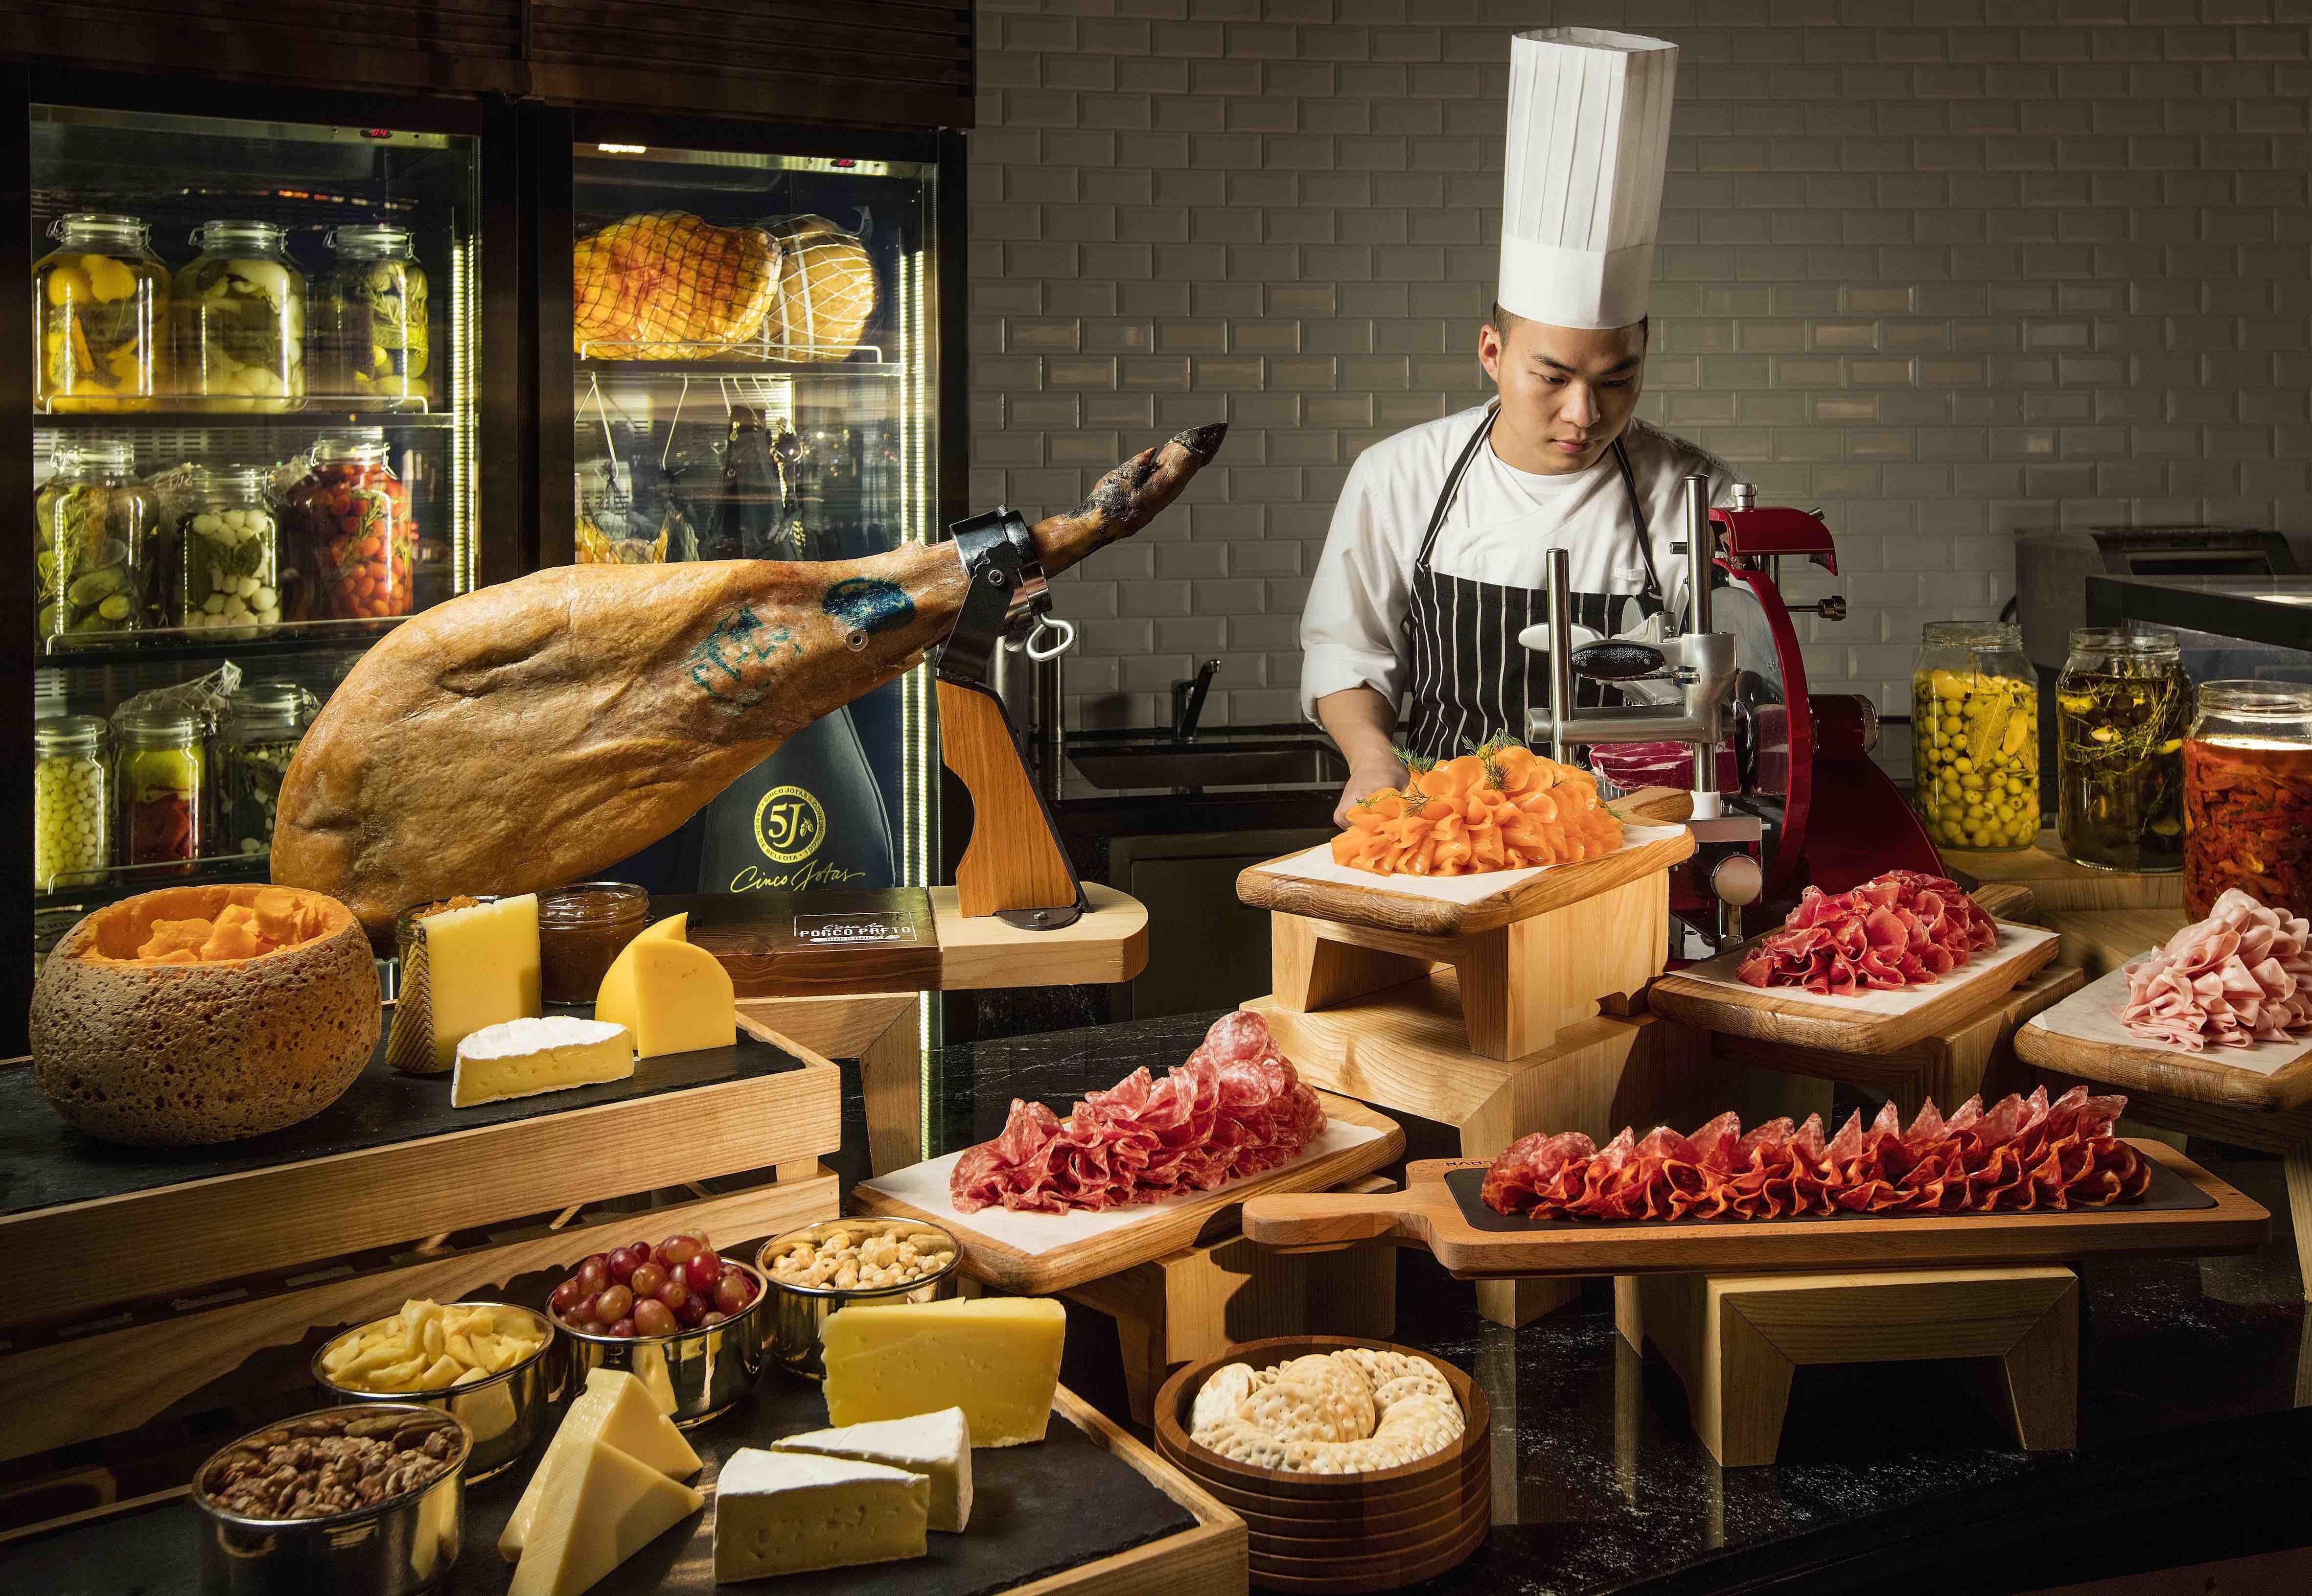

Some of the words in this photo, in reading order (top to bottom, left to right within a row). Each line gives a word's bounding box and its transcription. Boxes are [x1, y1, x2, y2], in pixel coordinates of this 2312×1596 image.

[764, 788, 783, 802] CINCO
[785, 787, 809, 798] JOTAS
[768, 803, 806, 848] 5J
[766, 849, 799, 861] BELLOTA
[730, 865, 788, 893] Cinco
[791, 859, 866, 891] Jotas
[799, 928, 854, 937] PORCO
